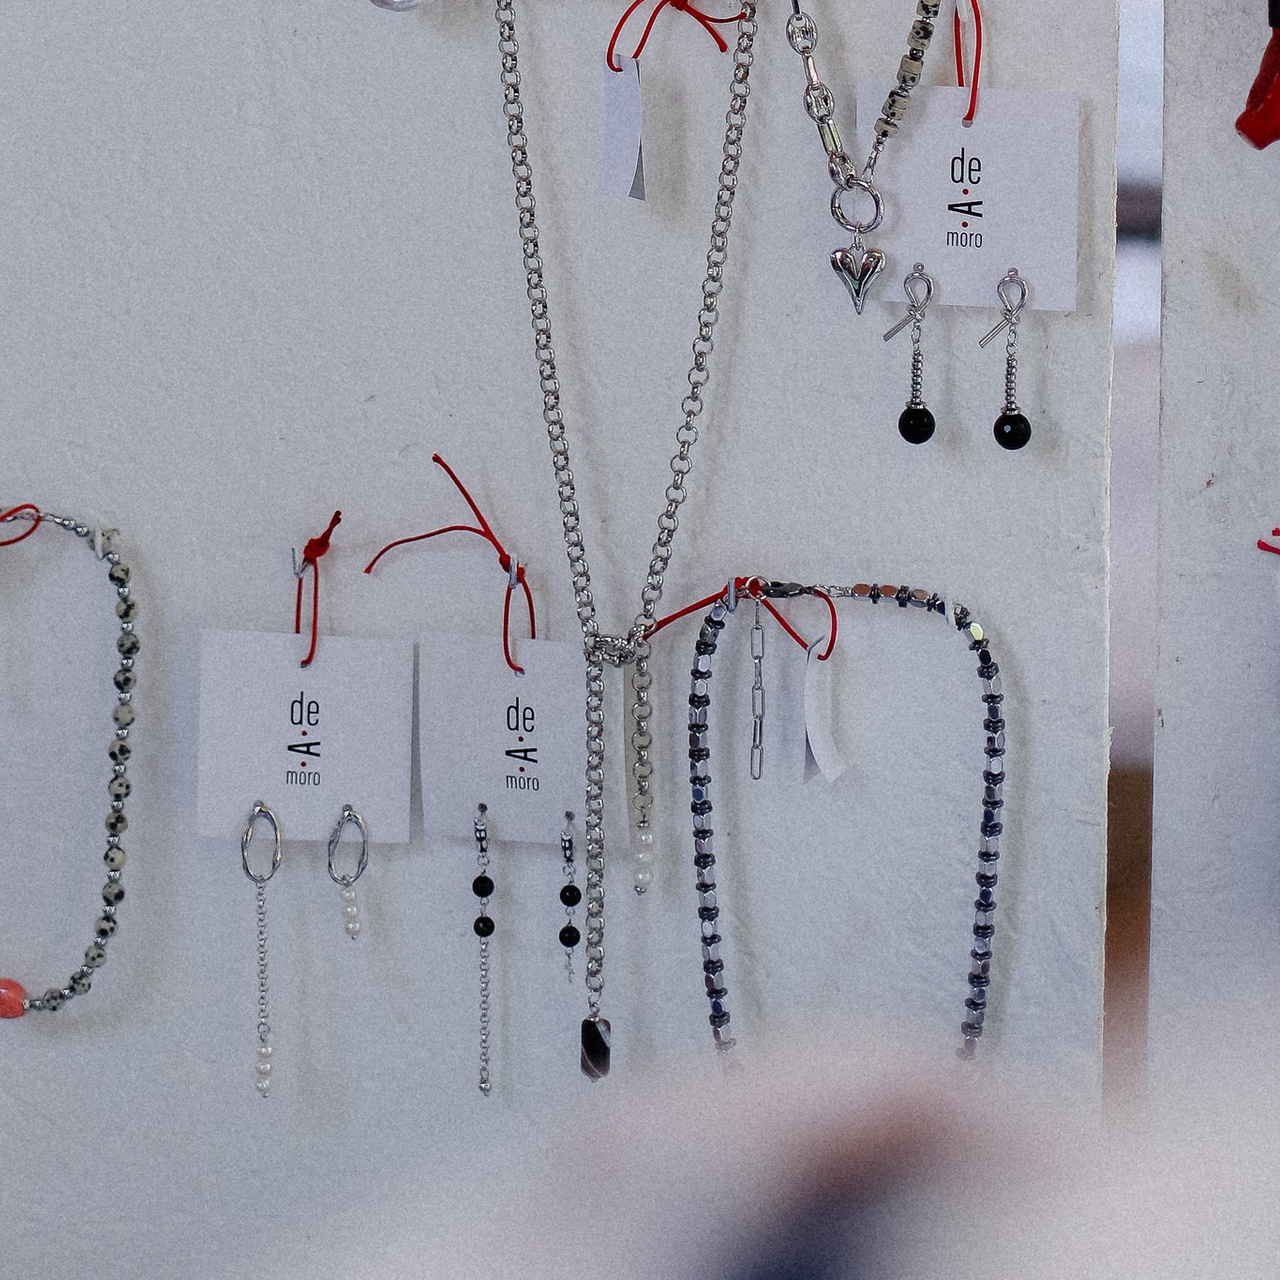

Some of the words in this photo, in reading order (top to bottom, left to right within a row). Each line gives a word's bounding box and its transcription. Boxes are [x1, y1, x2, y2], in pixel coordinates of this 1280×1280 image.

[951, 147, 982, 185] de
[947, 232, 983, 248] moro
[290, 691, 319, 726] de
[507, 697, 535, 733] de
[286, 770, 321, 786] moro
[506, 775, 540, 791] moro
